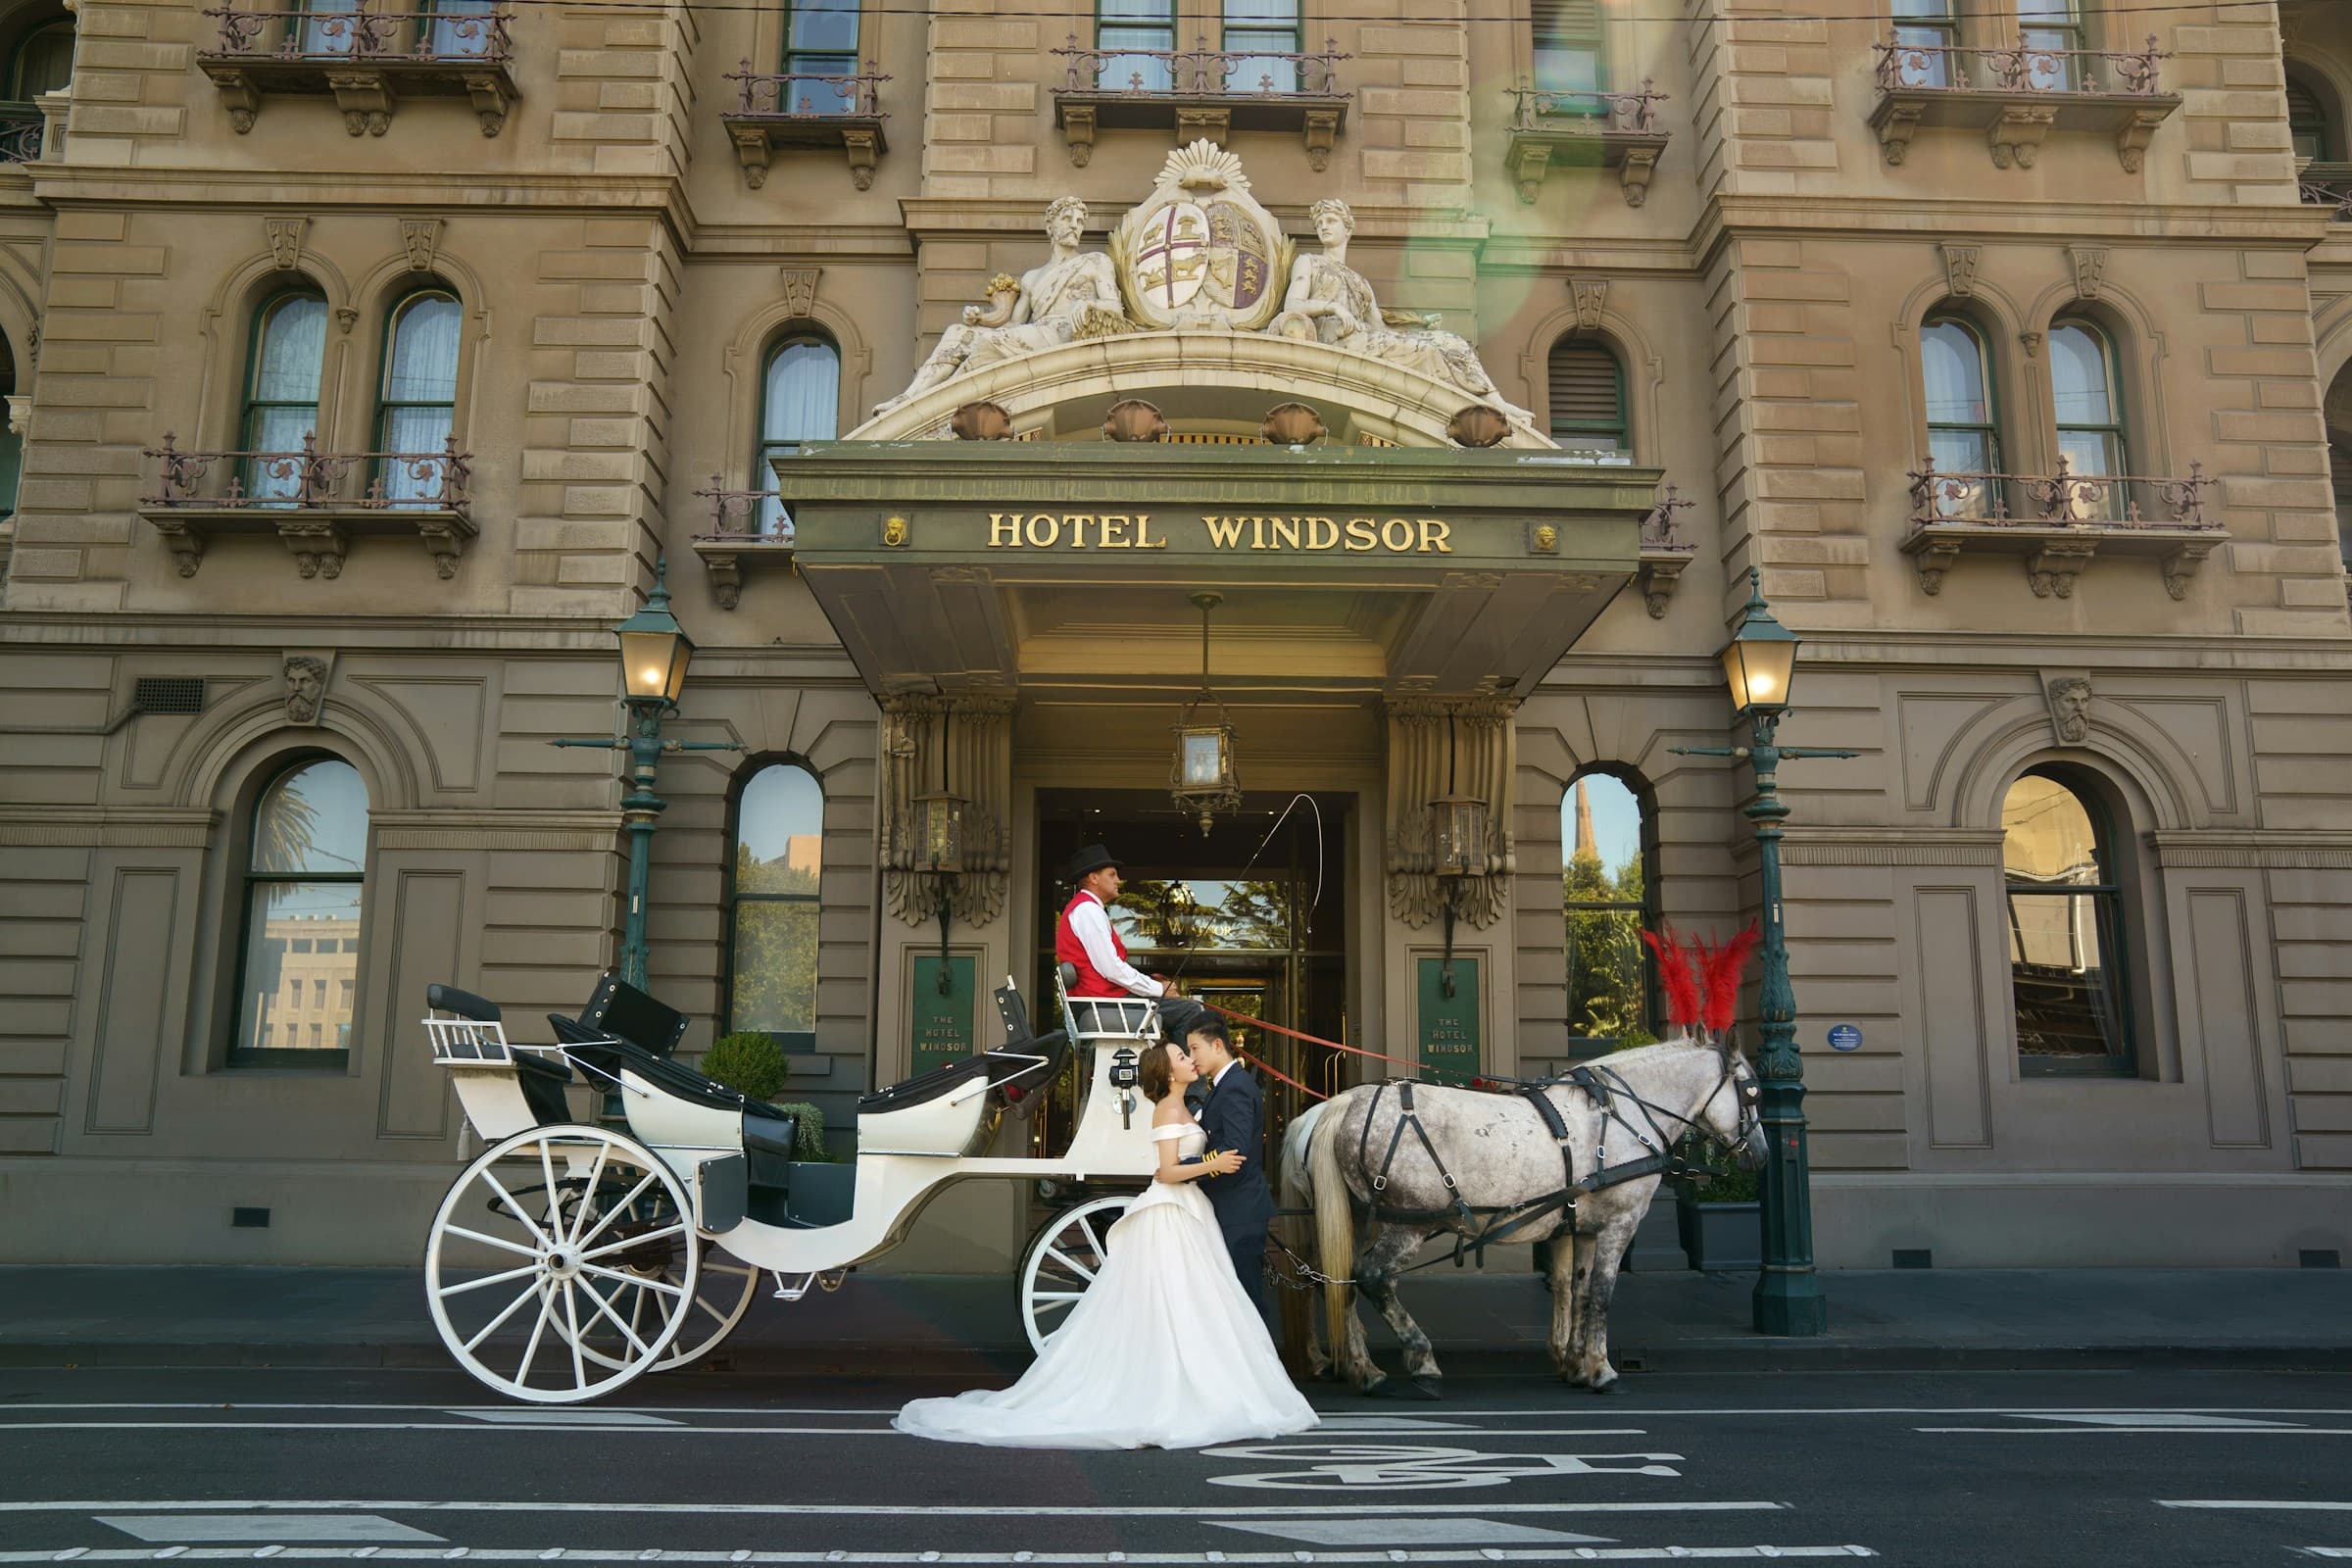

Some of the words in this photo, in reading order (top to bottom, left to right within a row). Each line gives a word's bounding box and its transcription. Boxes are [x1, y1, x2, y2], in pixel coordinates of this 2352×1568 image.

[987, 513, 1167, 549] HOTEL
[1201, 515, 1453, 553] WINDSOR
[925, 1028, 960, 1037] HOTEL
[1433, 1030, 1467, 1040] HOTEL
[919, 1042, 966, 1052] WINDSOR
[1427, 1044, 1473, 1053] WINDSOR
